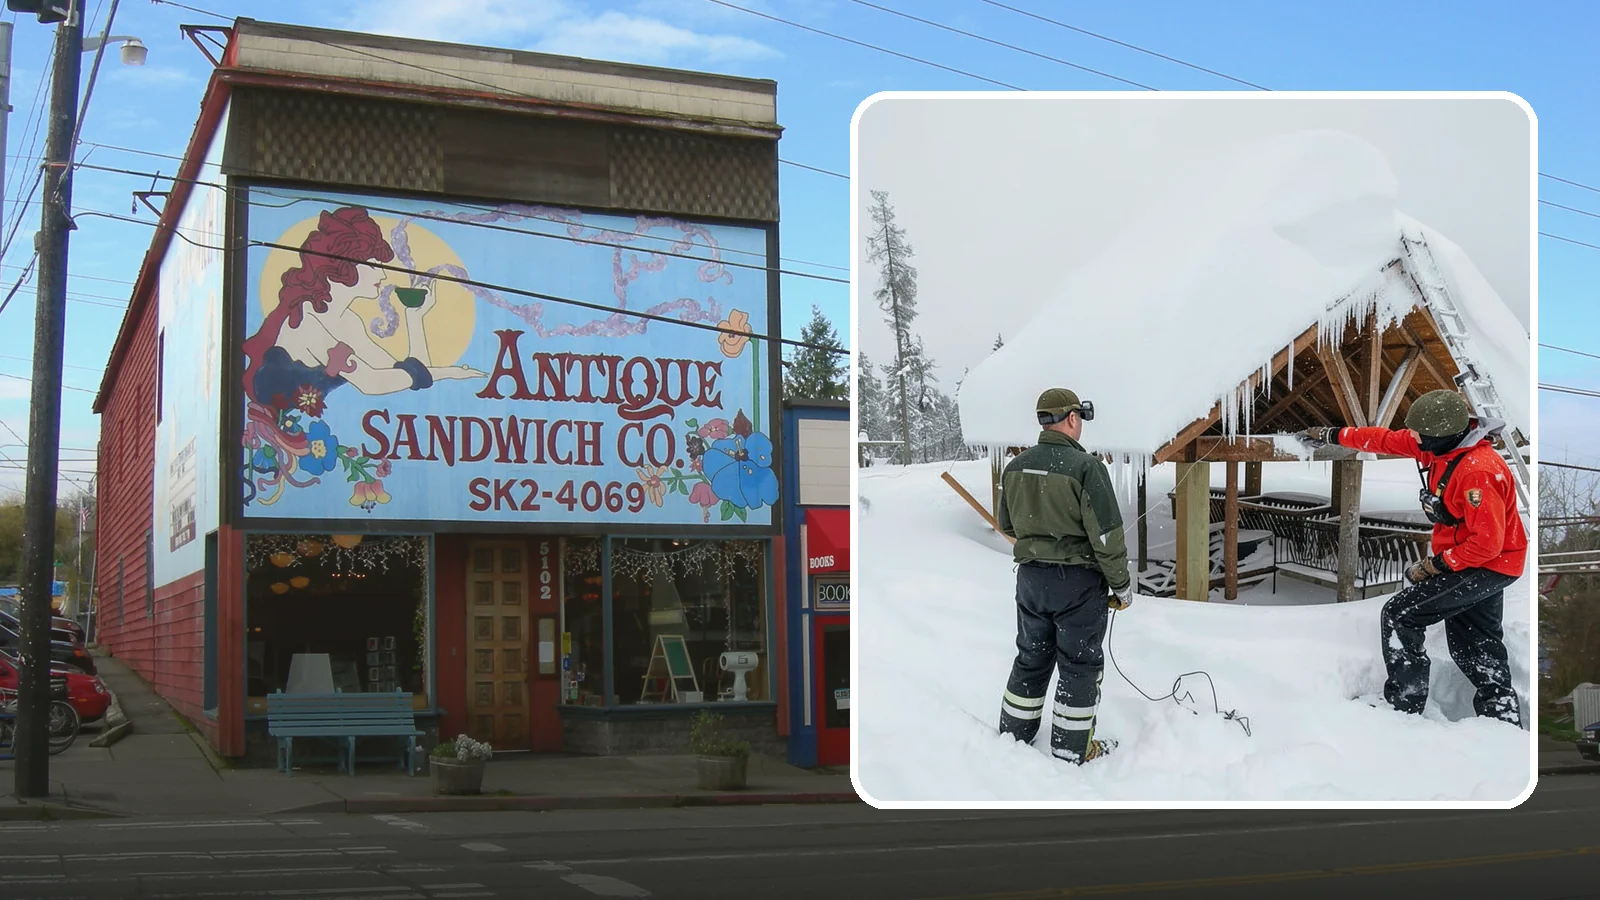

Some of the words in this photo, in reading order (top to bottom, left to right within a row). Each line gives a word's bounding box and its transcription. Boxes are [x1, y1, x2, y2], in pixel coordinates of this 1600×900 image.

[476, 329, 723, 419] ANTIQUE
[361, 409, 605, 466] SANDWICH
[617, 423, 685, 469] CO.
[469, 477, 645, 514] SK2-4069
[539, 541, 552, 600] 5102
[809, 555, 835, 569] BOOKS
